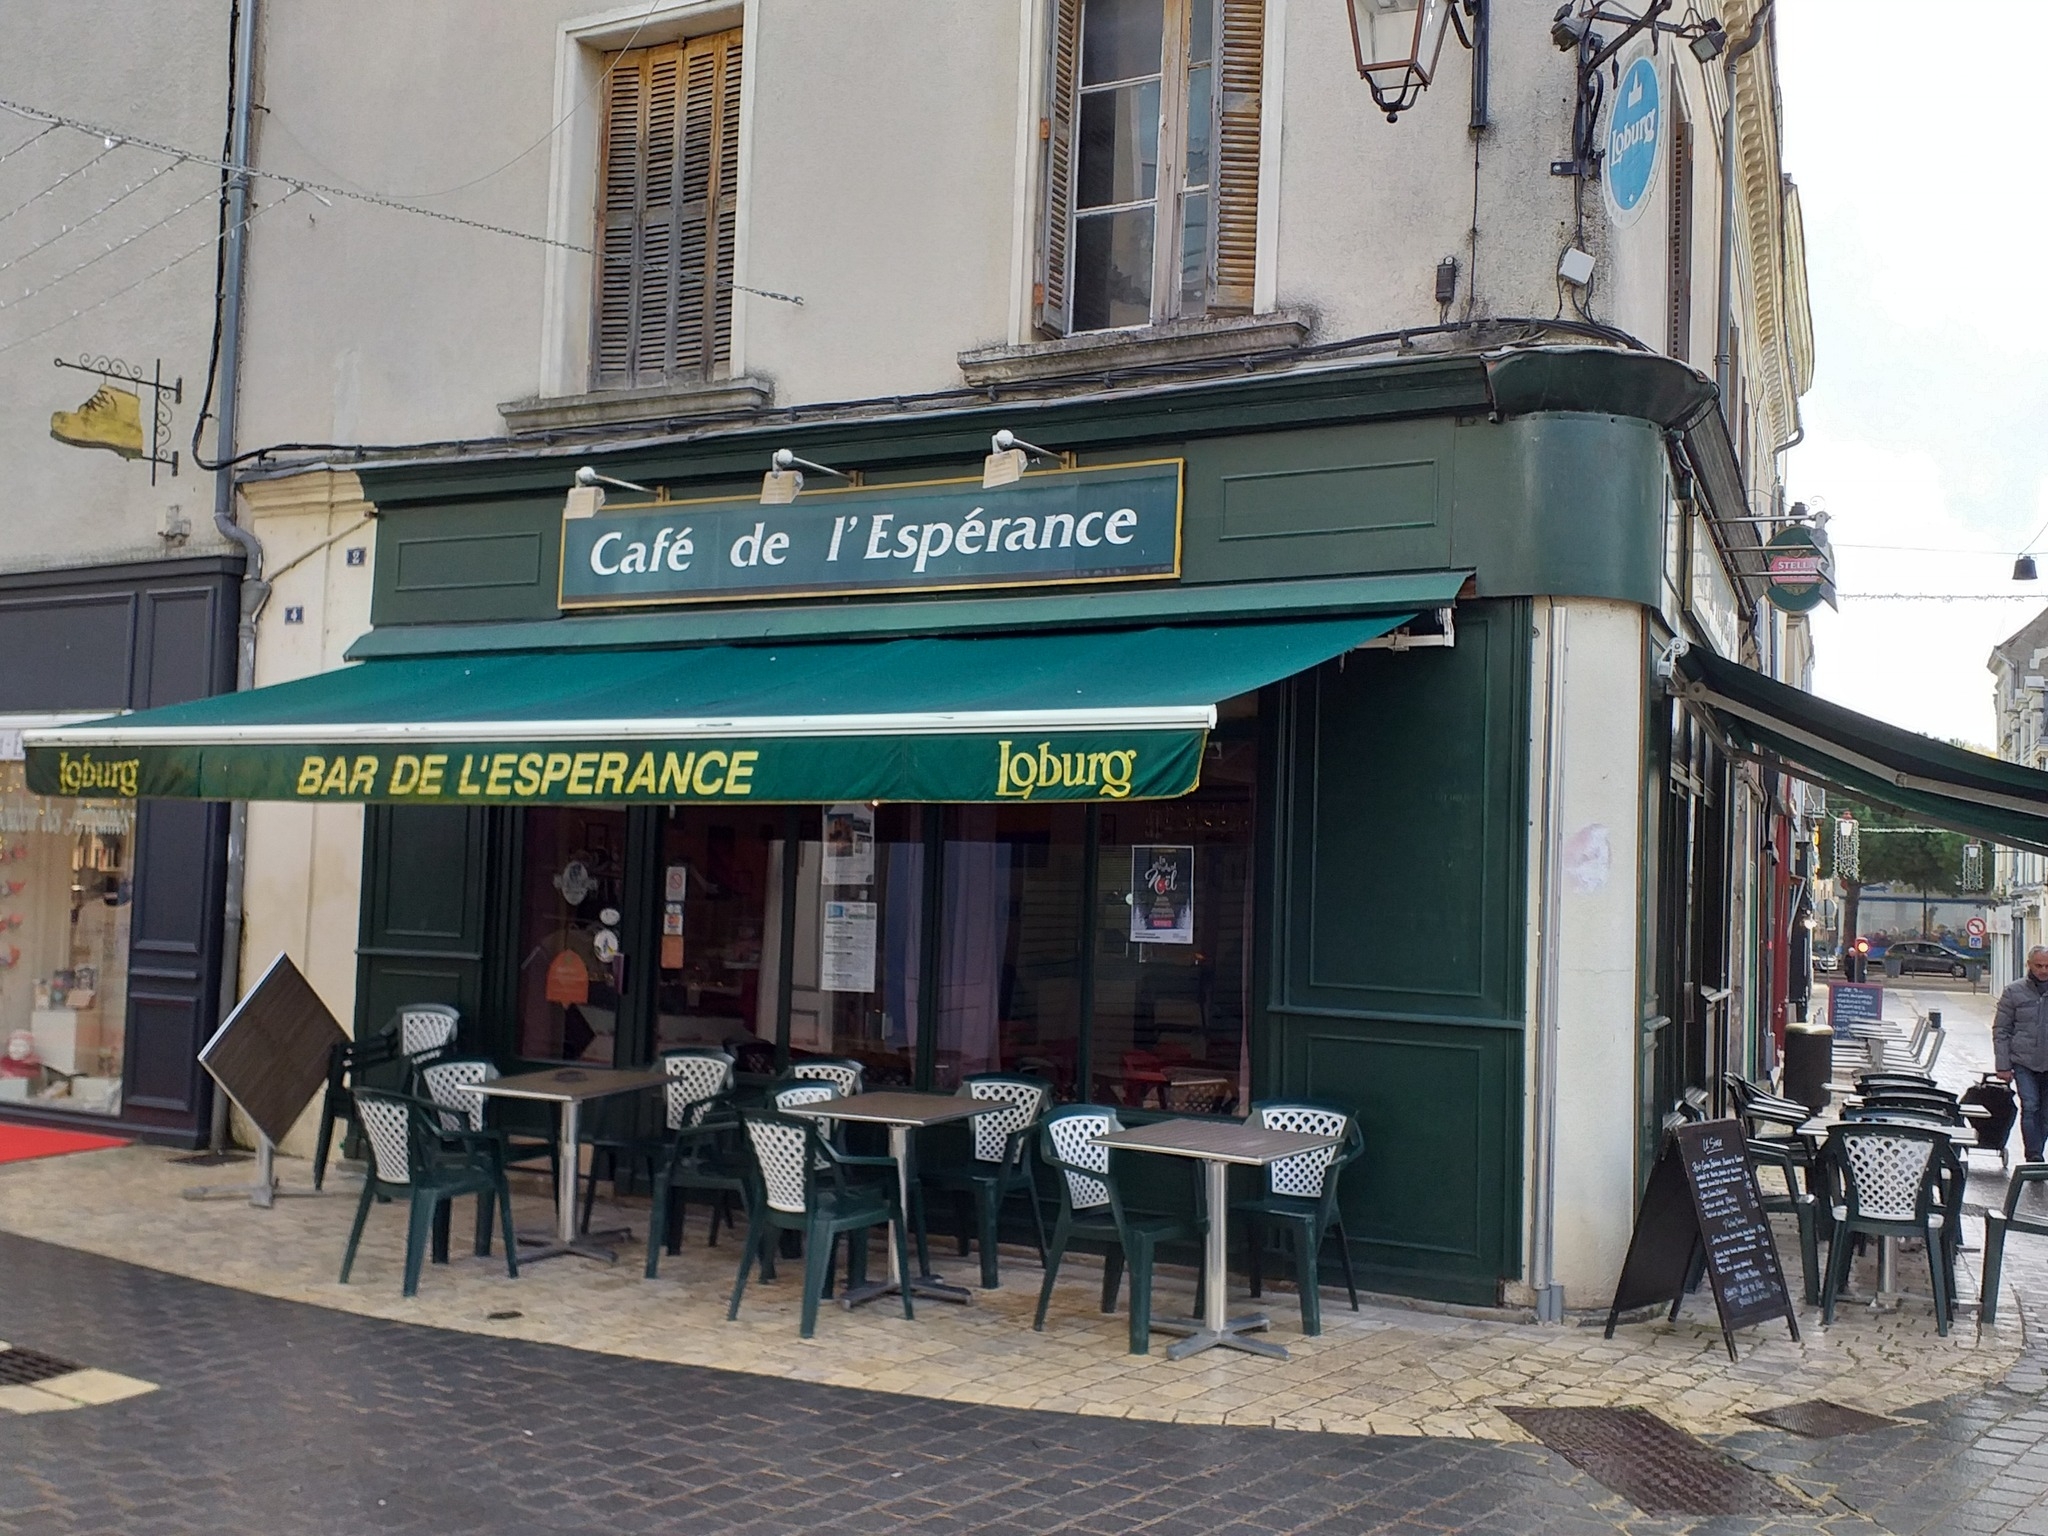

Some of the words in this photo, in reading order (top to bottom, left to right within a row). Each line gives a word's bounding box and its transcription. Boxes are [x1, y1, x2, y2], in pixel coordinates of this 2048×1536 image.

[1611, 108, 1655, 166] Loburg
[352, 550, 361, 564] 2
[590, 526, 695, 576] Café
[730, 522, 791, 568] de
[826, 505, 1139, 573] l'Espérance
[1778, 561, 1816, 570] STELLA
[290, 607, 298, 622] 4
[59, 751, 140, 797] Loburg
[296, 754, 379, 795] BAR
[388, 754, 449, 795] DE
[458, 751, 757, 795] L'ESPERANCE
[995, 740, 1137, 799] Loburg
